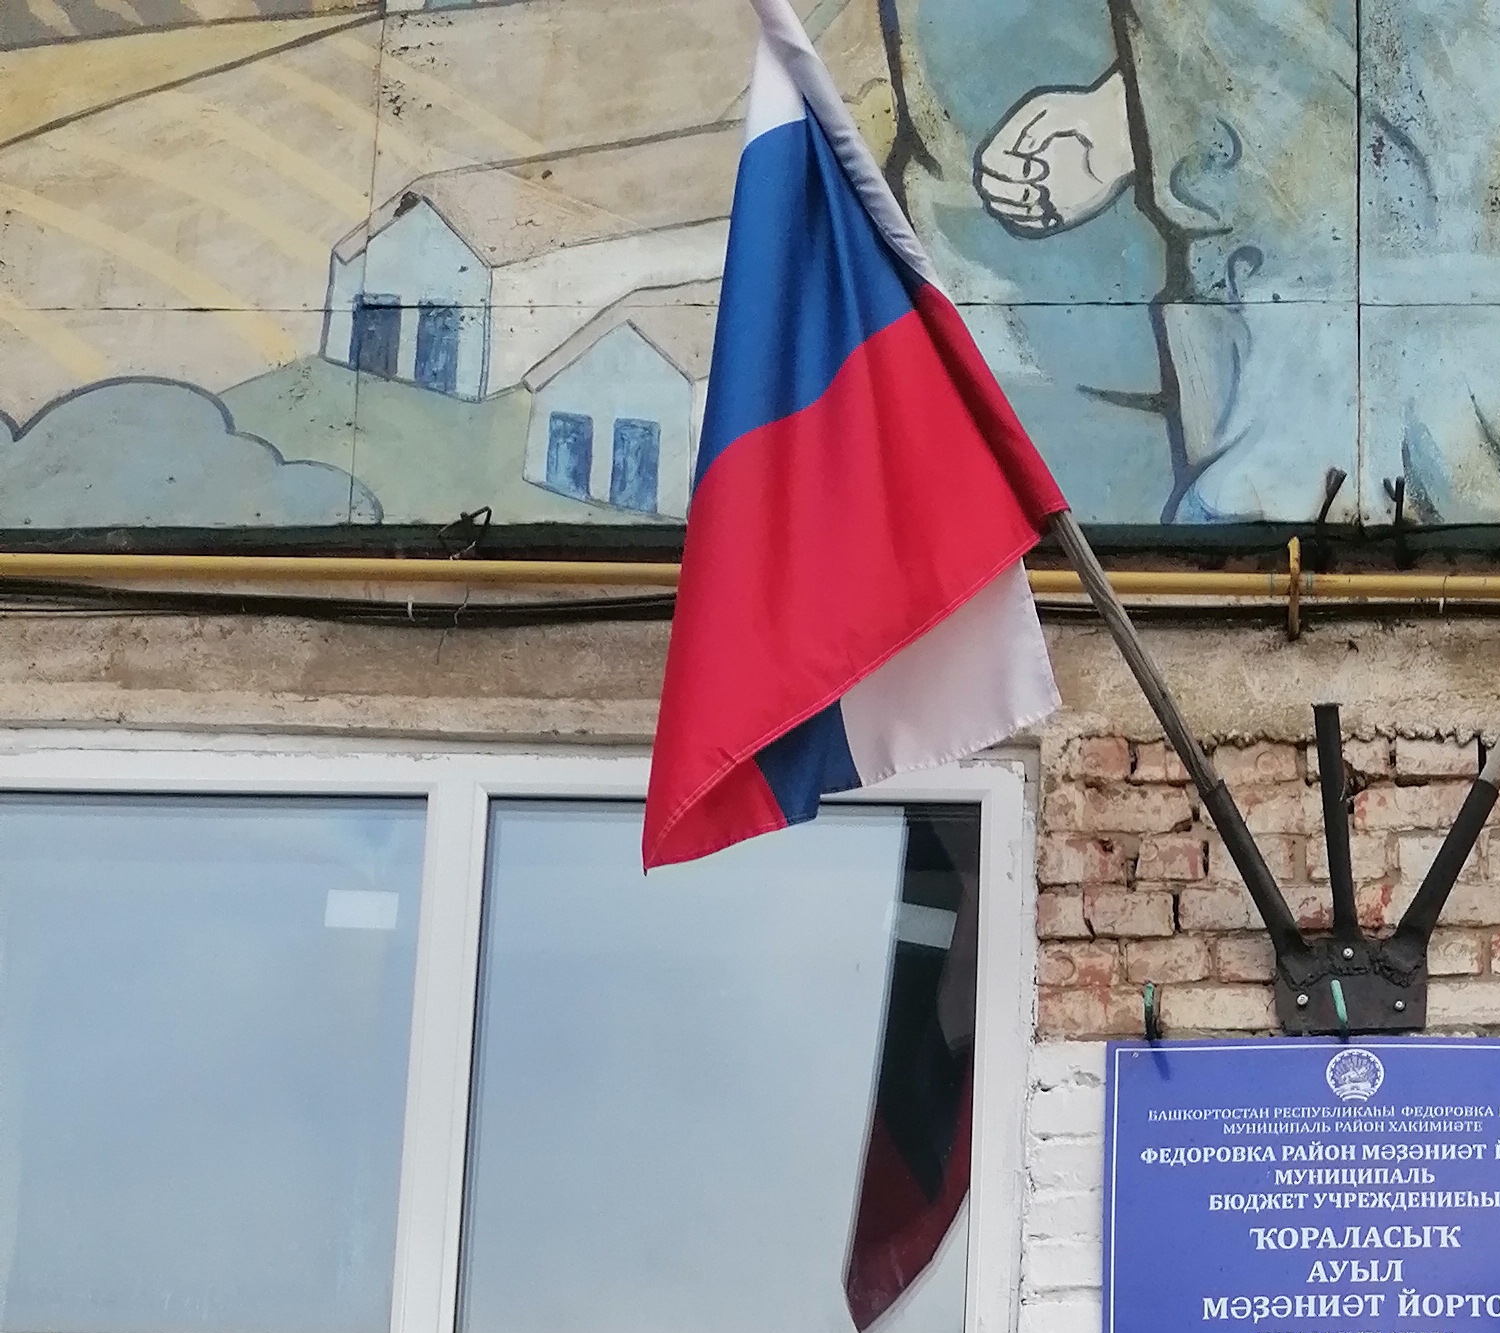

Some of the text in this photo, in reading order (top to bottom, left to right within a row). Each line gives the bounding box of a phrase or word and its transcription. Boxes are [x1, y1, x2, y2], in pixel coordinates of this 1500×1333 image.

[1402, 1104, 1494, 1118] ФЕДОРОВКА
[1223, 1121, 1330, 1135] МУНИЦИПАЛЬ
[1335, 1119, 1384, 1132] РАЙОН
[1140, 1146, 1276, 1166] ФЕДОРОВКА
[1282, 1141, 1356, 1161] РАЙОН
[1274, 1167, 1435, 1188] МУНИЦИПАЛЬ
[1208, 1192, 1309, 1213] БЮДЖЕТ
[1250, 1225, 1461, 1250] ҠОРАЛАСЫҠ
[1306, 1260, 1404, 1283] АУЫЛ
[1202, 1295, 1384, 1325] МӘҘӘНИӘТ
